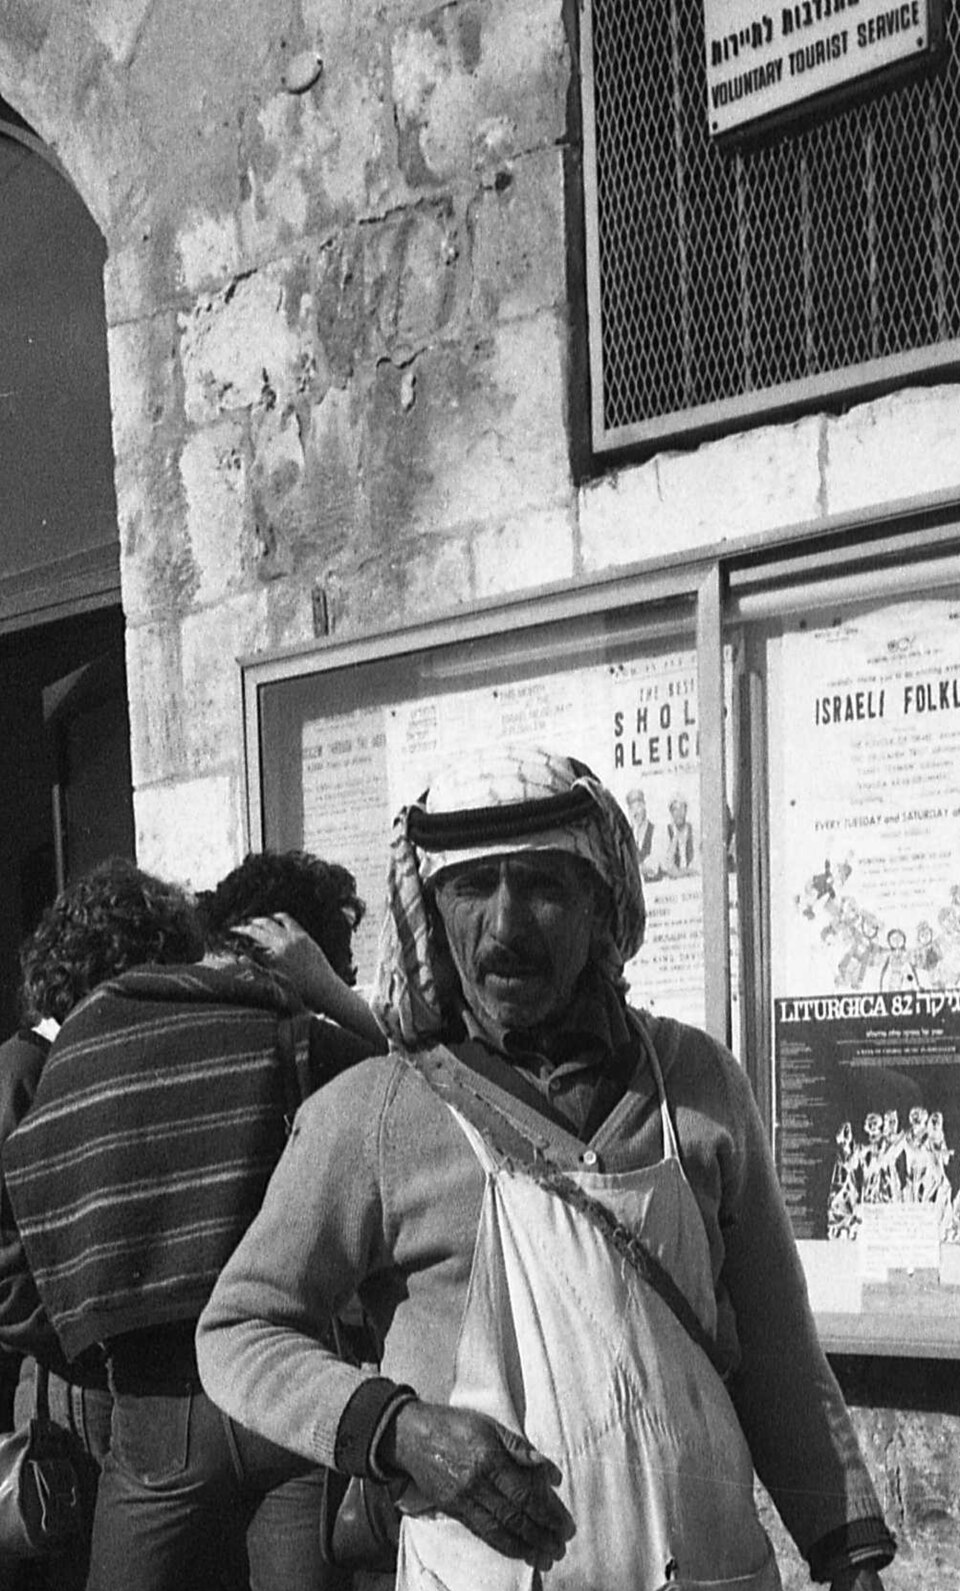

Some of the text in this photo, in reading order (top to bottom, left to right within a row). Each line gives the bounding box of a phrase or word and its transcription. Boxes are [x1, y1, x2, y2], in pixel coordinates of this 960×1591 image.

[711, 15, 773, 66] לתיירות
[711, 1, 919, 109] VOLUNTARY TOURIST SERVICE
[614, 699, 696, 737] SHOL
[815, 689, 885, 726] ISRAELI
[815, 820, 840, 831] EVERY
[844, 815, 882, 829] TUESDAY
[884, 813, 899, 825] and
[902, 808, 948, 823] SATURDAY
[780, 994, 913, 1022] LITURGICA 82
